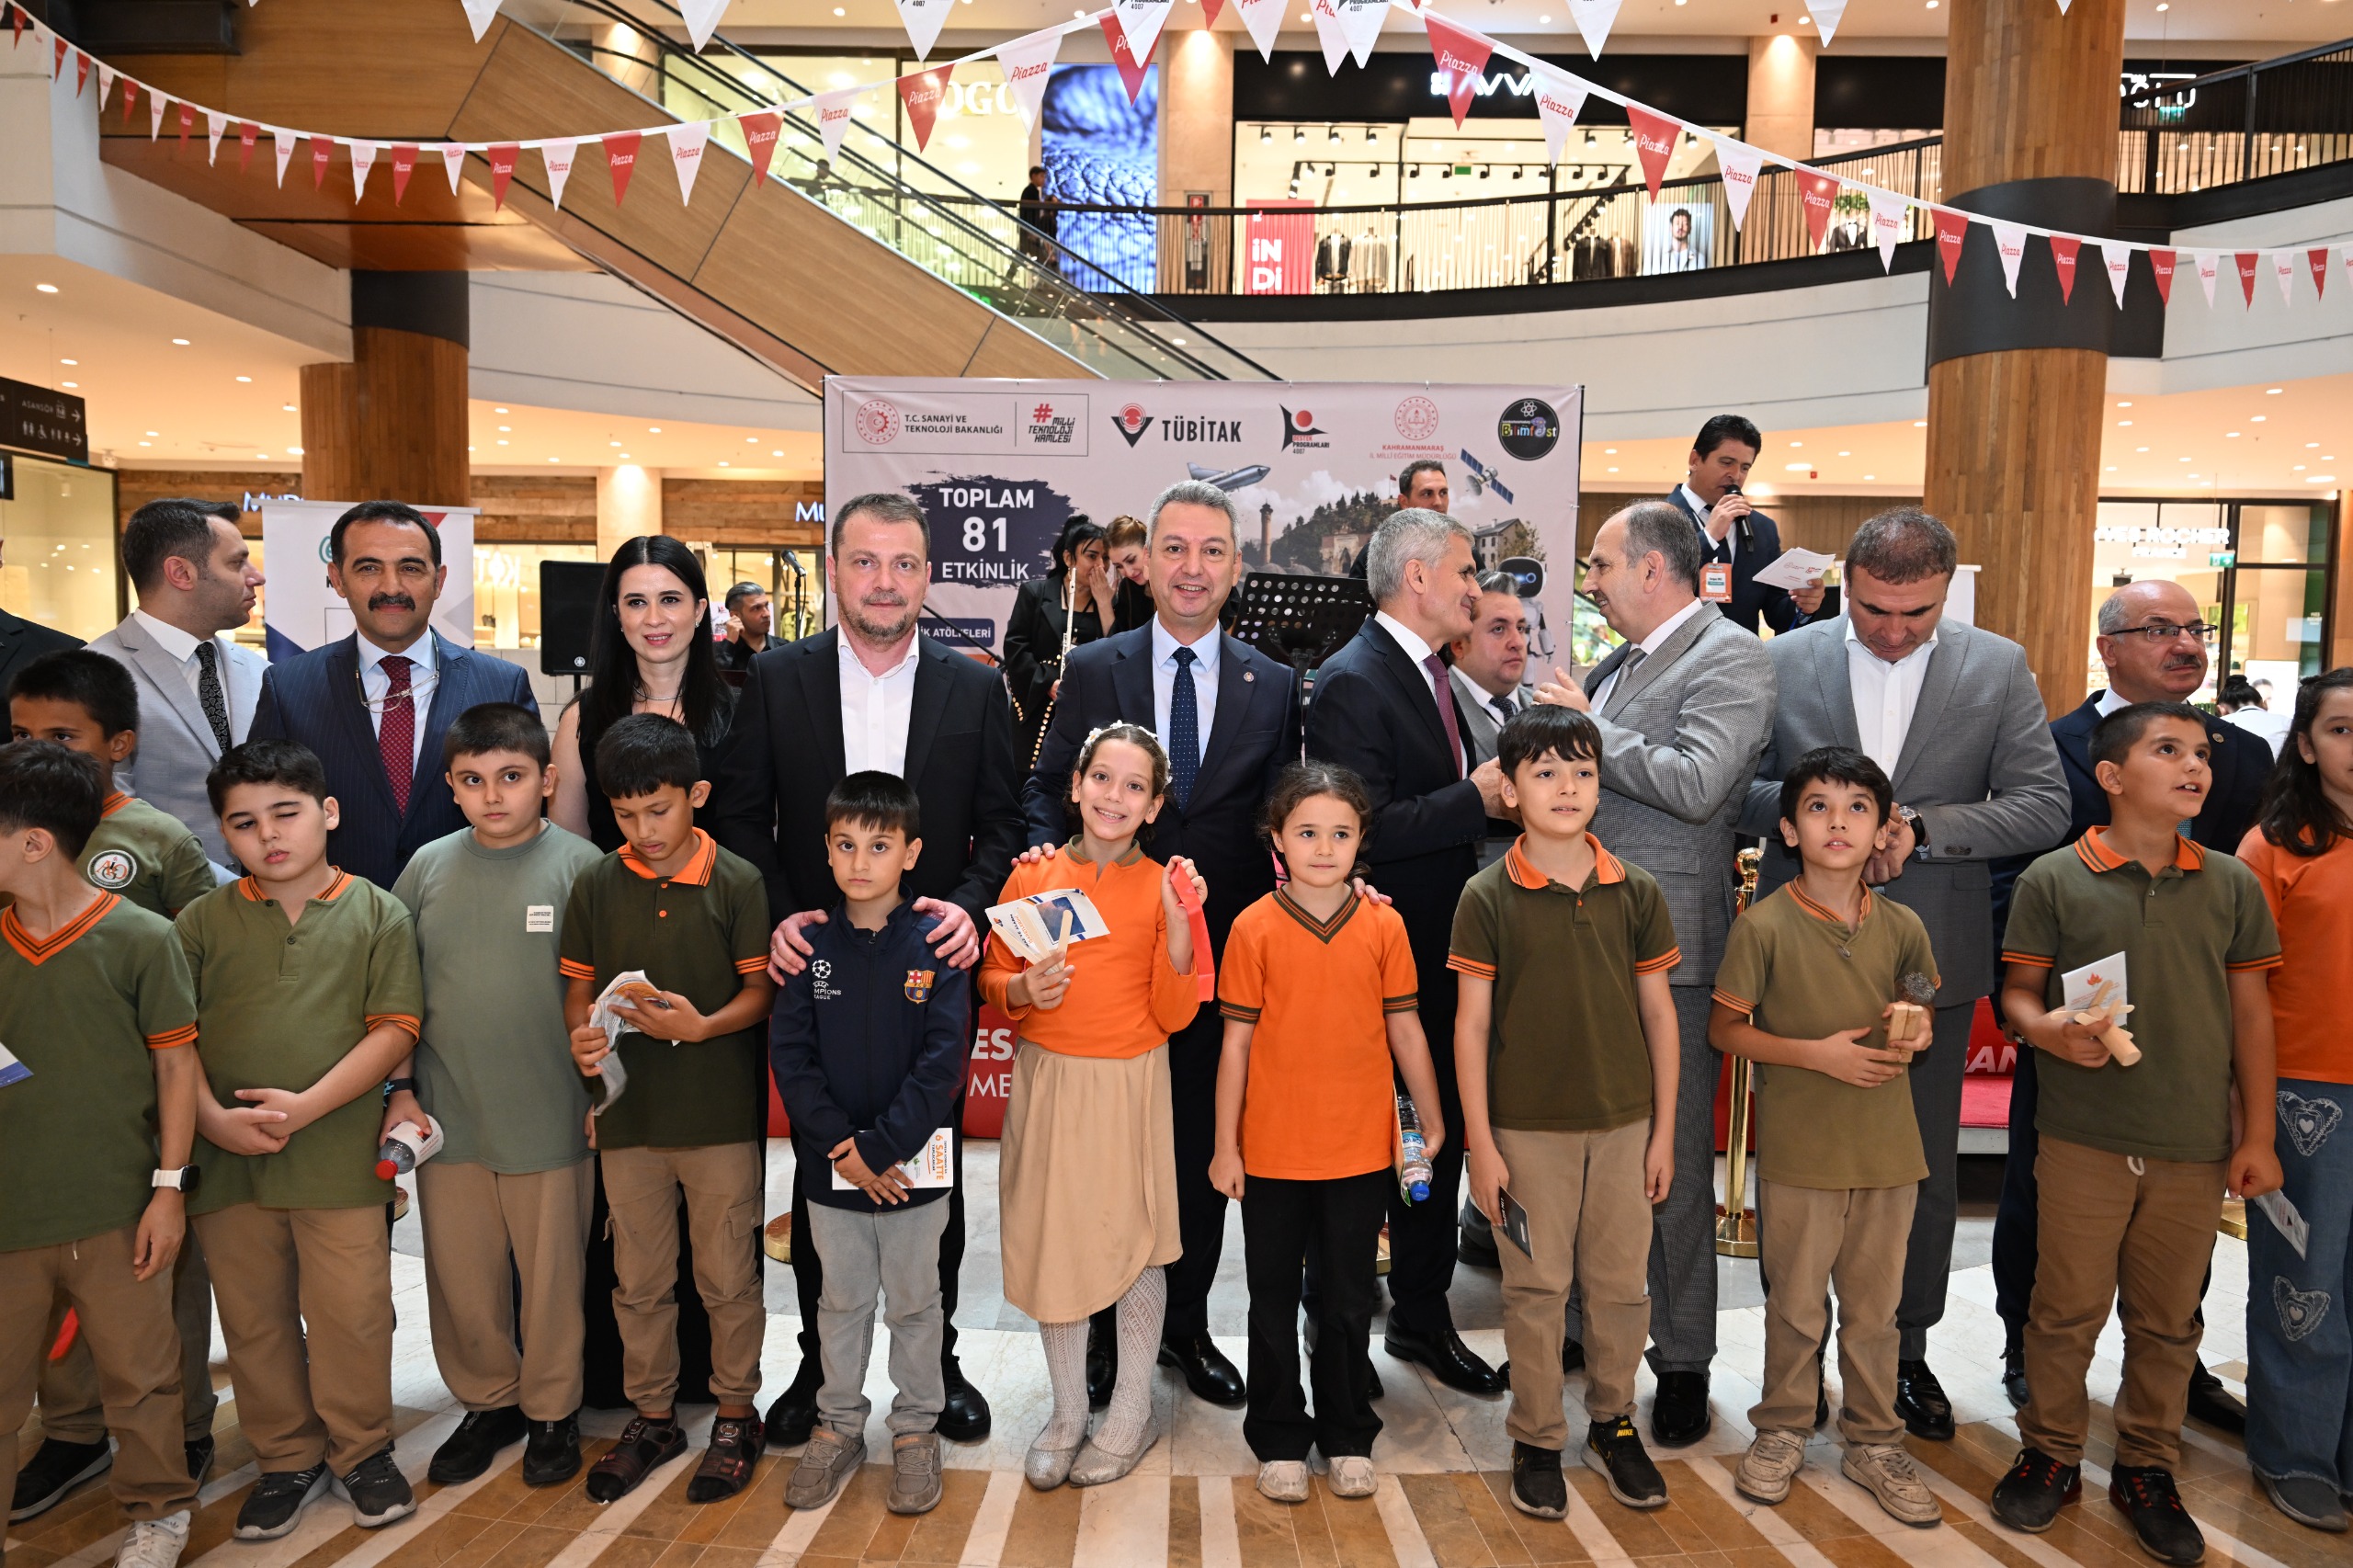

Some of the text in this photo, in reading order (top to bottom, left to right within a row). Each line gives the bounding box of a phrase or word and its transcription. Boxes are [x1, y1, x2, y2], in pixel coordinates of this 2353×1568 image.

[1439, 50, 1479, 75] Piazza
[1011, 61, 1047, 82] Piazza
[908, 89, 941, 107] Piazza
[1540, 94, 1574, 119] Piazza
[821, 108, 848, 123] Piazza
[749, 131, 776, 145] Piazza
[1639, 134, 1670, 156] Piazza
[611, 154, 633, 166] Piazza
[676, 146, 700, 160] Piazza
[493, 163, 512, 174] Piazza
[549, 161, 569, 172] Piazza
[1724, 165, 1753, 185] Piazza
[1804, 190, 1830, 209] Piazza
[1875, 213, 1898, 229] Piazza
[1938, 230, 1961, 244] Piazza
[2001, 244, 2021, 256] Piazza
[2057, 253, 2075, 266] Piazza
[2109, 260, 2126, 272] Piazza
[2155, 264, 2173, 275] Piazza
[905, 415, 919, 423] T.C.
[922, 413, 953, 423] SANAYİ
[905, 425, 1003, 434] TEKNOLOJİ BAKANLIĞI
[1162, 415, 1242, 442] TÜBİTAK
[938, 488, 1034, 508] TOPLAM
[962, 517, 1006, 551] 81
[2145, 527, 2231, 544] ROCHER
[942, 559, 1029, 579] ETKİNLİK
[936, 1144, 944, 1180] SAATTE
